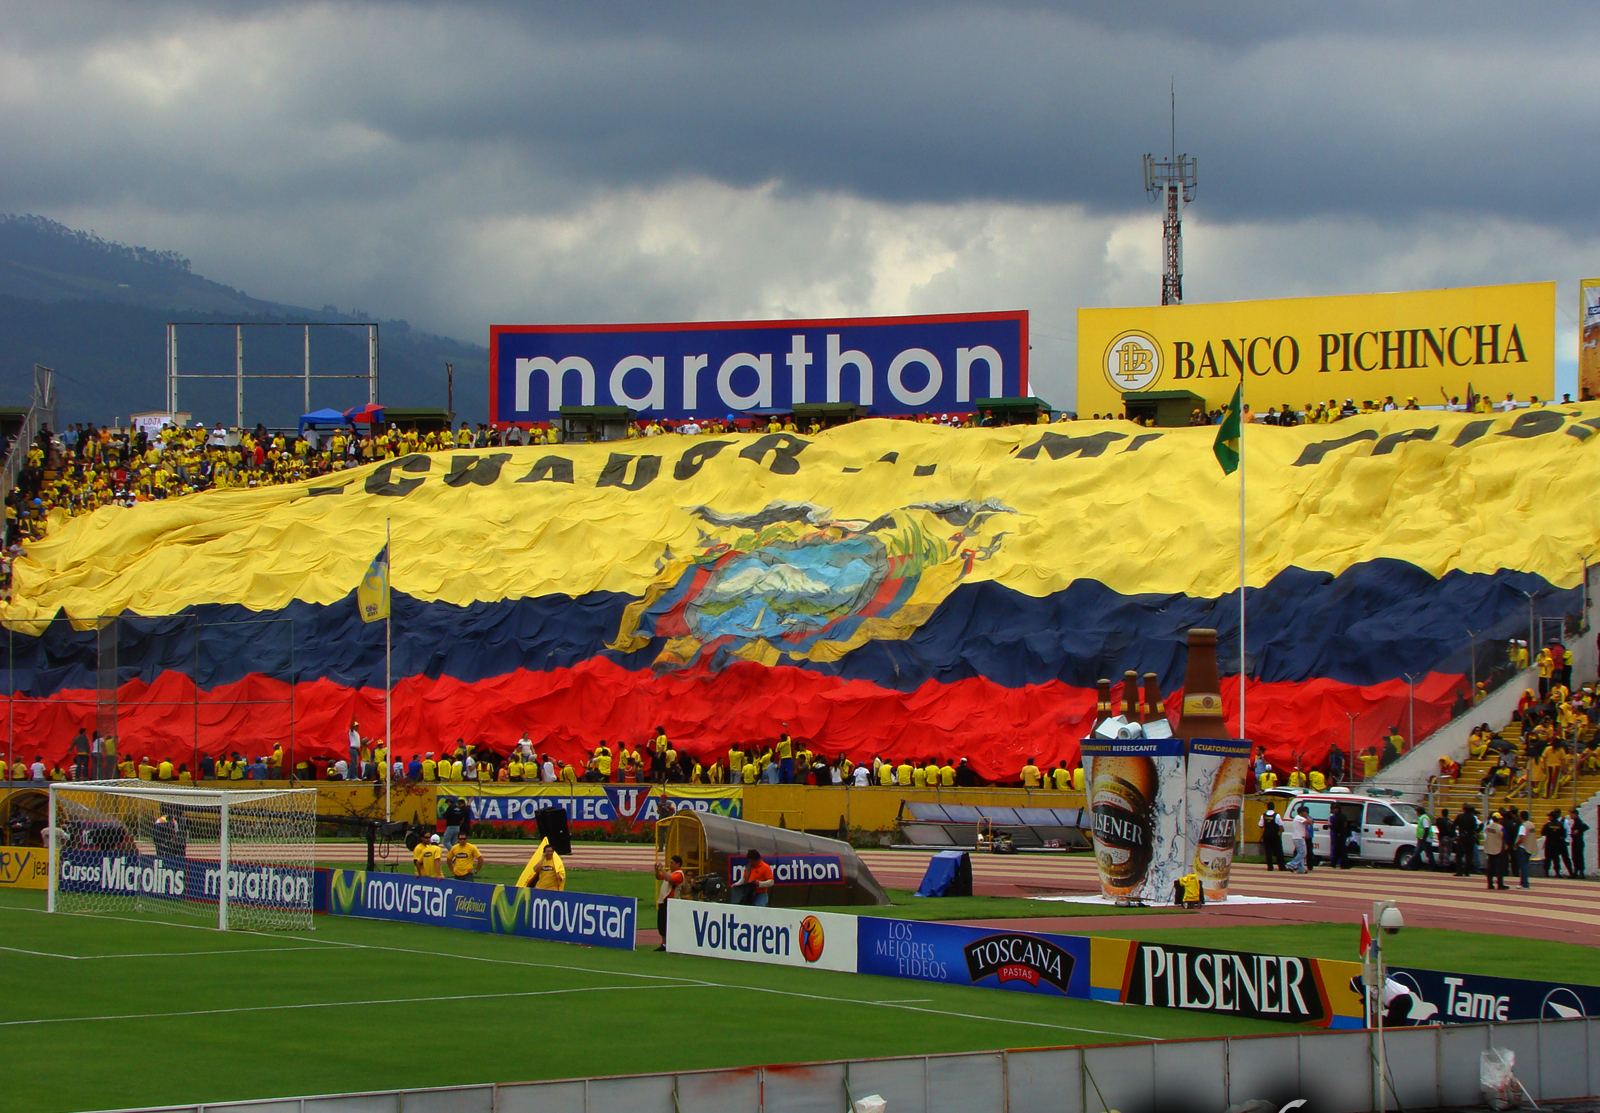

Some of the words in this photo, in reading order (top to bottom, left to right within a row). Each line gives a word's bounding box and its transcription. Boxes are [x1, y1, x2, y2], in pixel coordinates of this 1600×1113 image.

[1173, 335, 1300, 380] BANCO
[1319, 323, 1528, 373] PICHINCHA
[515, 333, 1004, 412] marathon
[470, 798, 502, 819] VA
[32, 857, 49, 879] jea
[61, 860, 100, 882] Cursos
[102, 856, 185, 895] Microlins
[733, 860, 840, 881] mrathon
[205, 867, 309, 903] marathon
[367, 880, 453, 918] movistar
[532, 898, 632, 939] movistar
[889, 922, 913, 941] LOS
[876, 939, 935, 961] MEJORES
[972, 939, 1062, 980] TOSCANA
[899, 957, 947, 979] FIDEOS
[1003, 968, 1033, 980] PASTAS
[1142, 945, 1310, 1015] PILSENER
